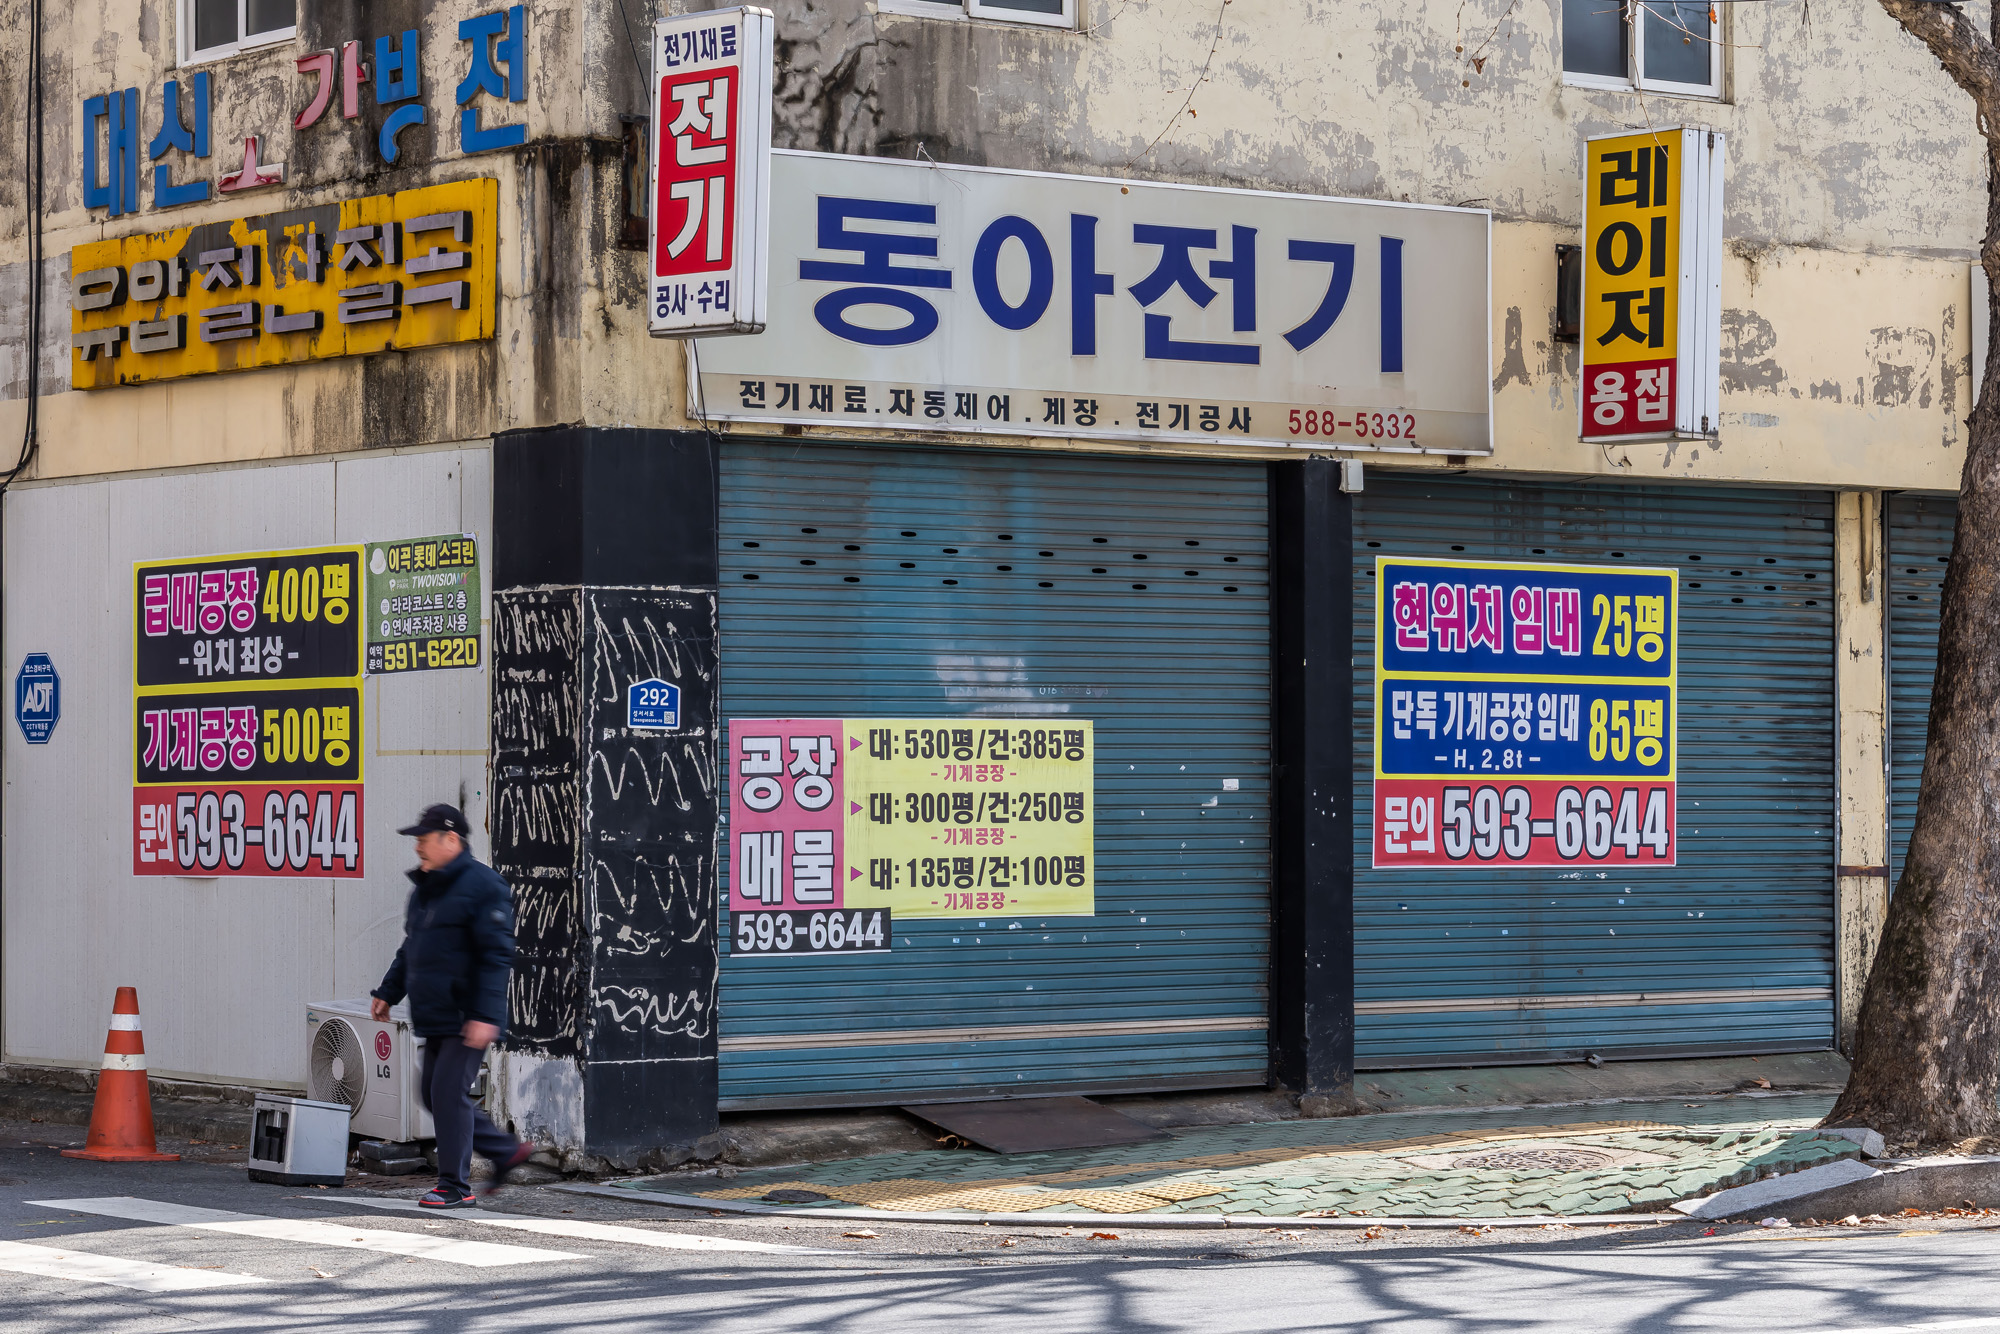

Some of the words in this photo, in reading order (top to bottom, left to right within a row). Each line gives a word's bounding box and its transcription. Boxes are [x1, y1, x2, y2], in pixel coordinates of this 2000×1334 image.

[664, 24, 737, 67] 전기재료
[666, 76, 730, 263] 전기
[1595, 145, 1669, 349] 레이저
[798, 194, 1406, 374] 동아전기
[1590, 366, 1670, 426] 용접
[1288, 409, 1416, 439] 588-5332
[439, 540, 474, 566] 스크린
[262, 563, 350, 625] 400평
[391, 593, 444, 615] 라라코스트
[392, 615, 444, 637] 연세주차장
[446, 614, 468, 633] 사용
[1393, 581, 1503, 654] 현위치
[1510, 585, 1581, 656] 임대
[1592, 593, 1665, 663] 25평
[369, 646, 383, 656] 예약
[369, 659, 383, 670] 문의
[384, 638, 477, 671] 591-6220
[22, 682, 53, 712] ADT
[640, 688, 669, 706] 292
[143, 706, 259, 771] 기계공장
[263, 705, 350, 766] 500평
[1392, 690, 1437, 740] 단독
[1443, 691, 1533, 742] 기계공장
[1538, 693, 1580, 742] 임대
[1588, 698, 1663, 767] 85평
[740, 735, 837, 812] 공장
[139, 803, 174, 863] 문의
[177, 791, 359, 870] 593-6644
[1384, 796, 1435, 854] 문의
[1442, 785, 1669, 860] 593-6644
[740, 830, 835, 905] 매물
[737, 911, 884, 951] 593-6644
[376, 1064, 391, 1079] LG
